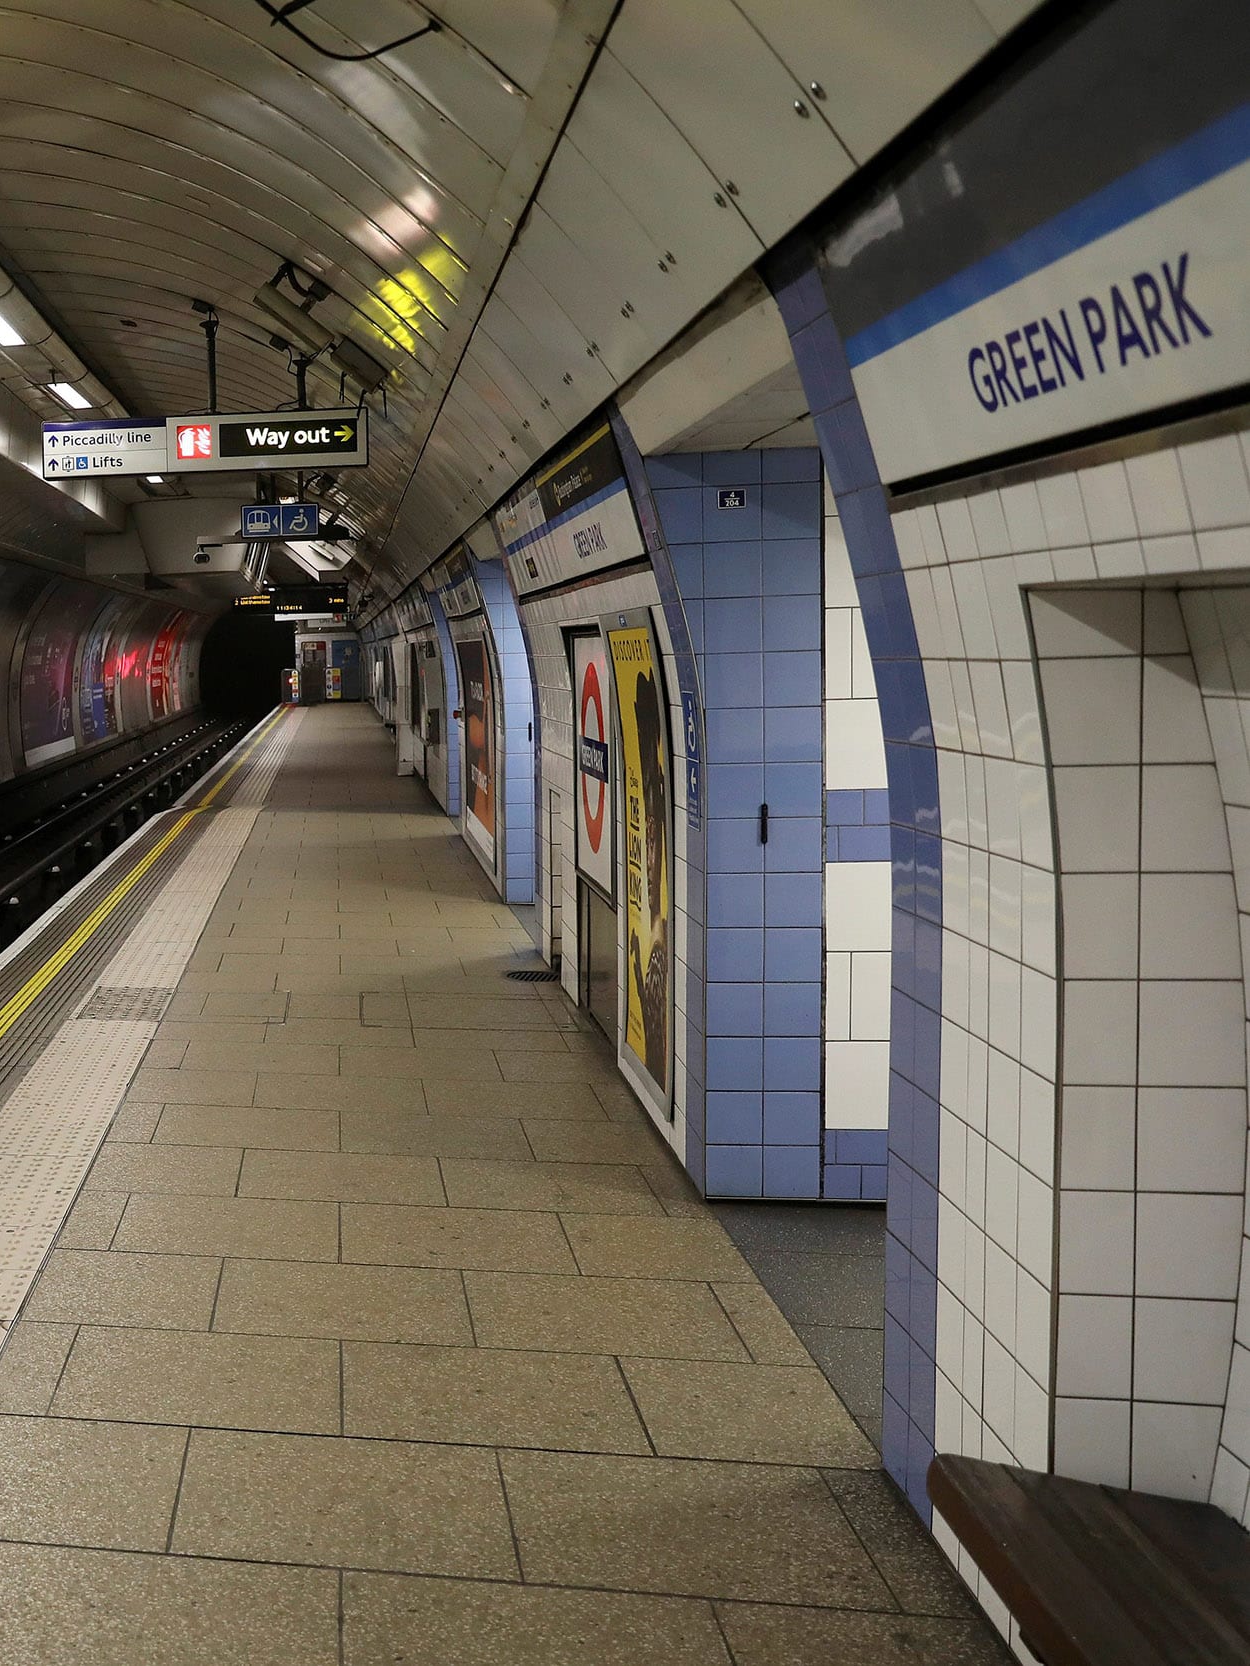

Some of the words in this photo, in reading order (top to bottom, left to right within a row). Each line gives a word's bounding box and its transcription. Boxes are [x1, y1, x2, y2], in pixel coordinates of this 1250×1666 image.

[967, 308, 1084, 413] GREEN
[1078, 251, 1212, 374] PARK
[62, 433, 124, 447] Piccadilly
[127, 431, 151, 443] line
[246, 427, 289, 448] Way
[294, 427, 330, 444] out
[92, 456, 123, 468] Lifts
[613, 639, 645, 661] DISCOVER
